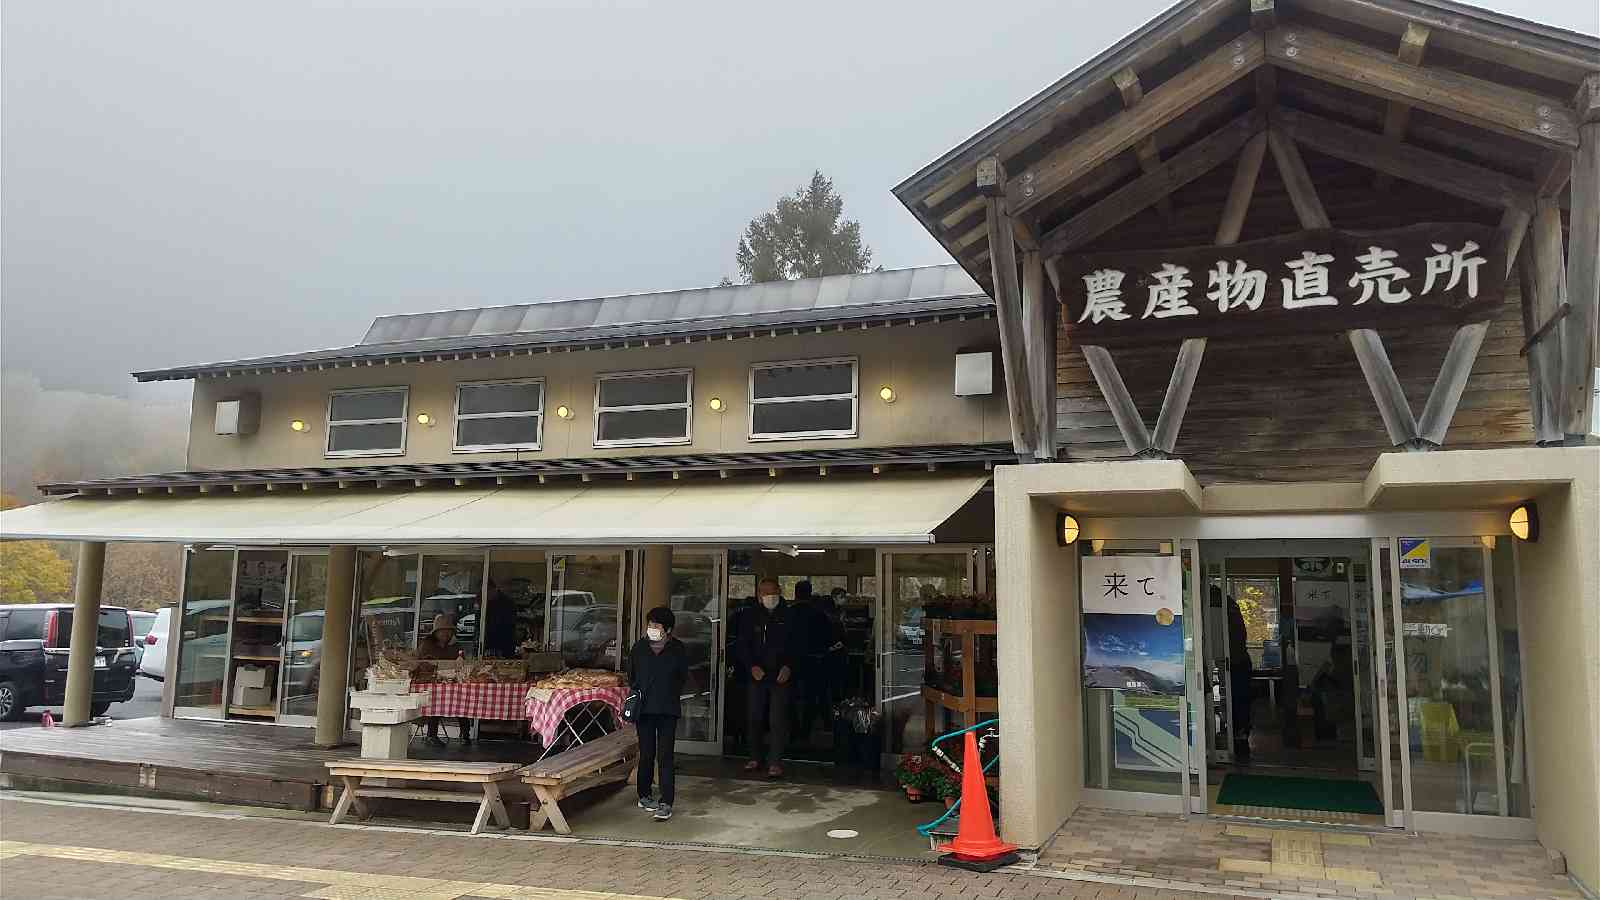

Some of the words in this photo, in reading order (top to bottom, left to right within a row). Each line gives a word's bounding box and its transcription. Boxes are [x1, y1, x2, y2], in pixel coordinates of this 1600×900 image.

[1077, 239, 1487, 325] 農産物直売所
[1103, 572, 1155, 599] 来て
